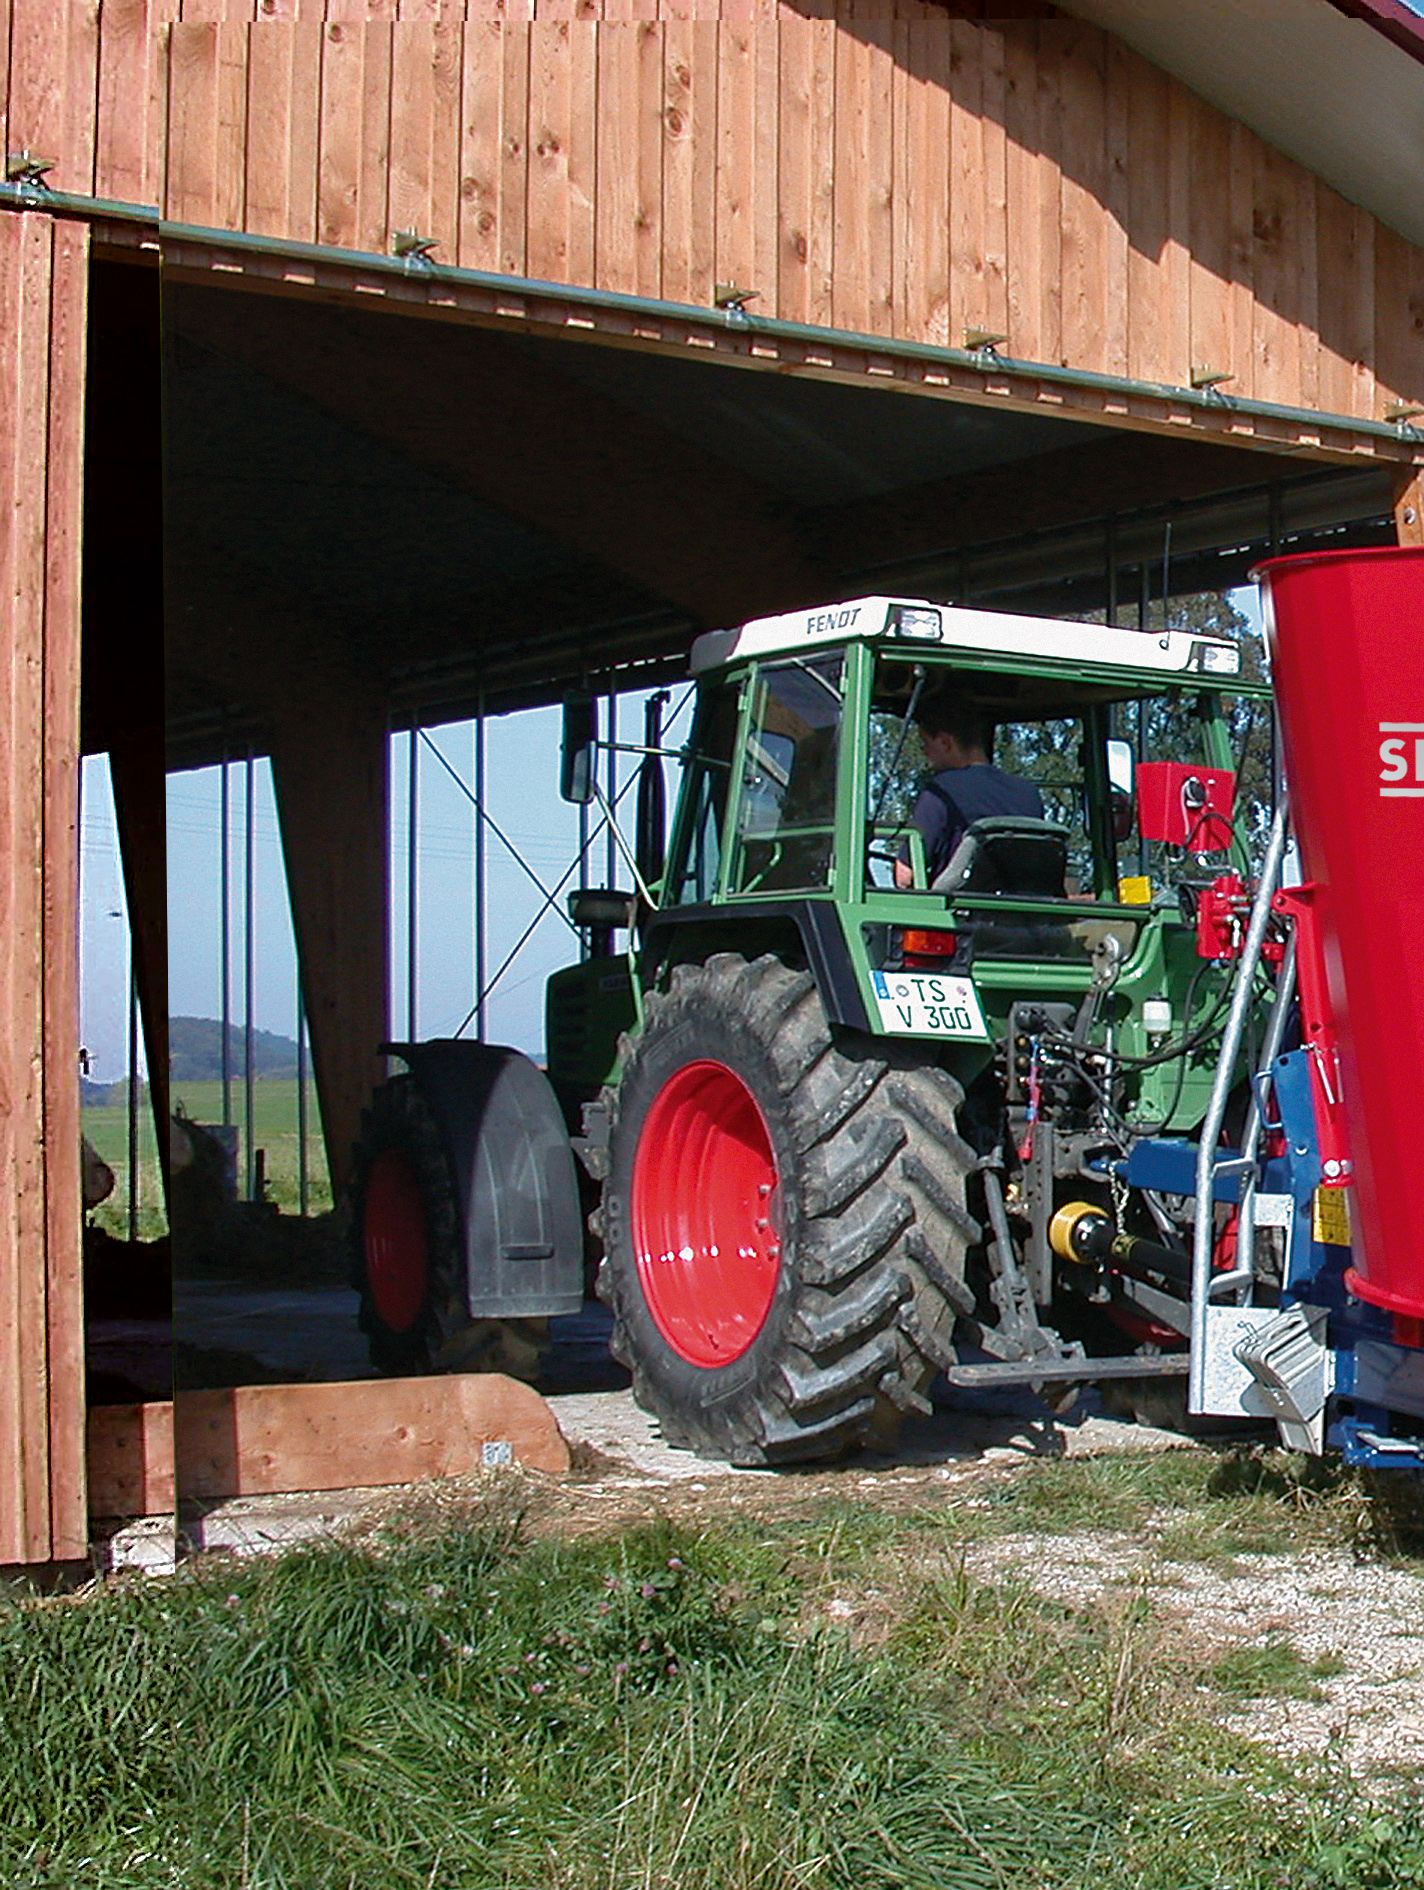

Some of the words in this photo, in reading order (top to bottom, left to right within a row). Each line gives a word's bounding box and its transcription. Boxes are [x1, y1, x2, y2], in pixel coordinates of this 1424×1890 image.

[806, 607, 862, 635] FENDT
[911, 979, 946, 1003] TS
[896, 1004, 912, 1028] V
[923, 1005, 972, 1030] 300
